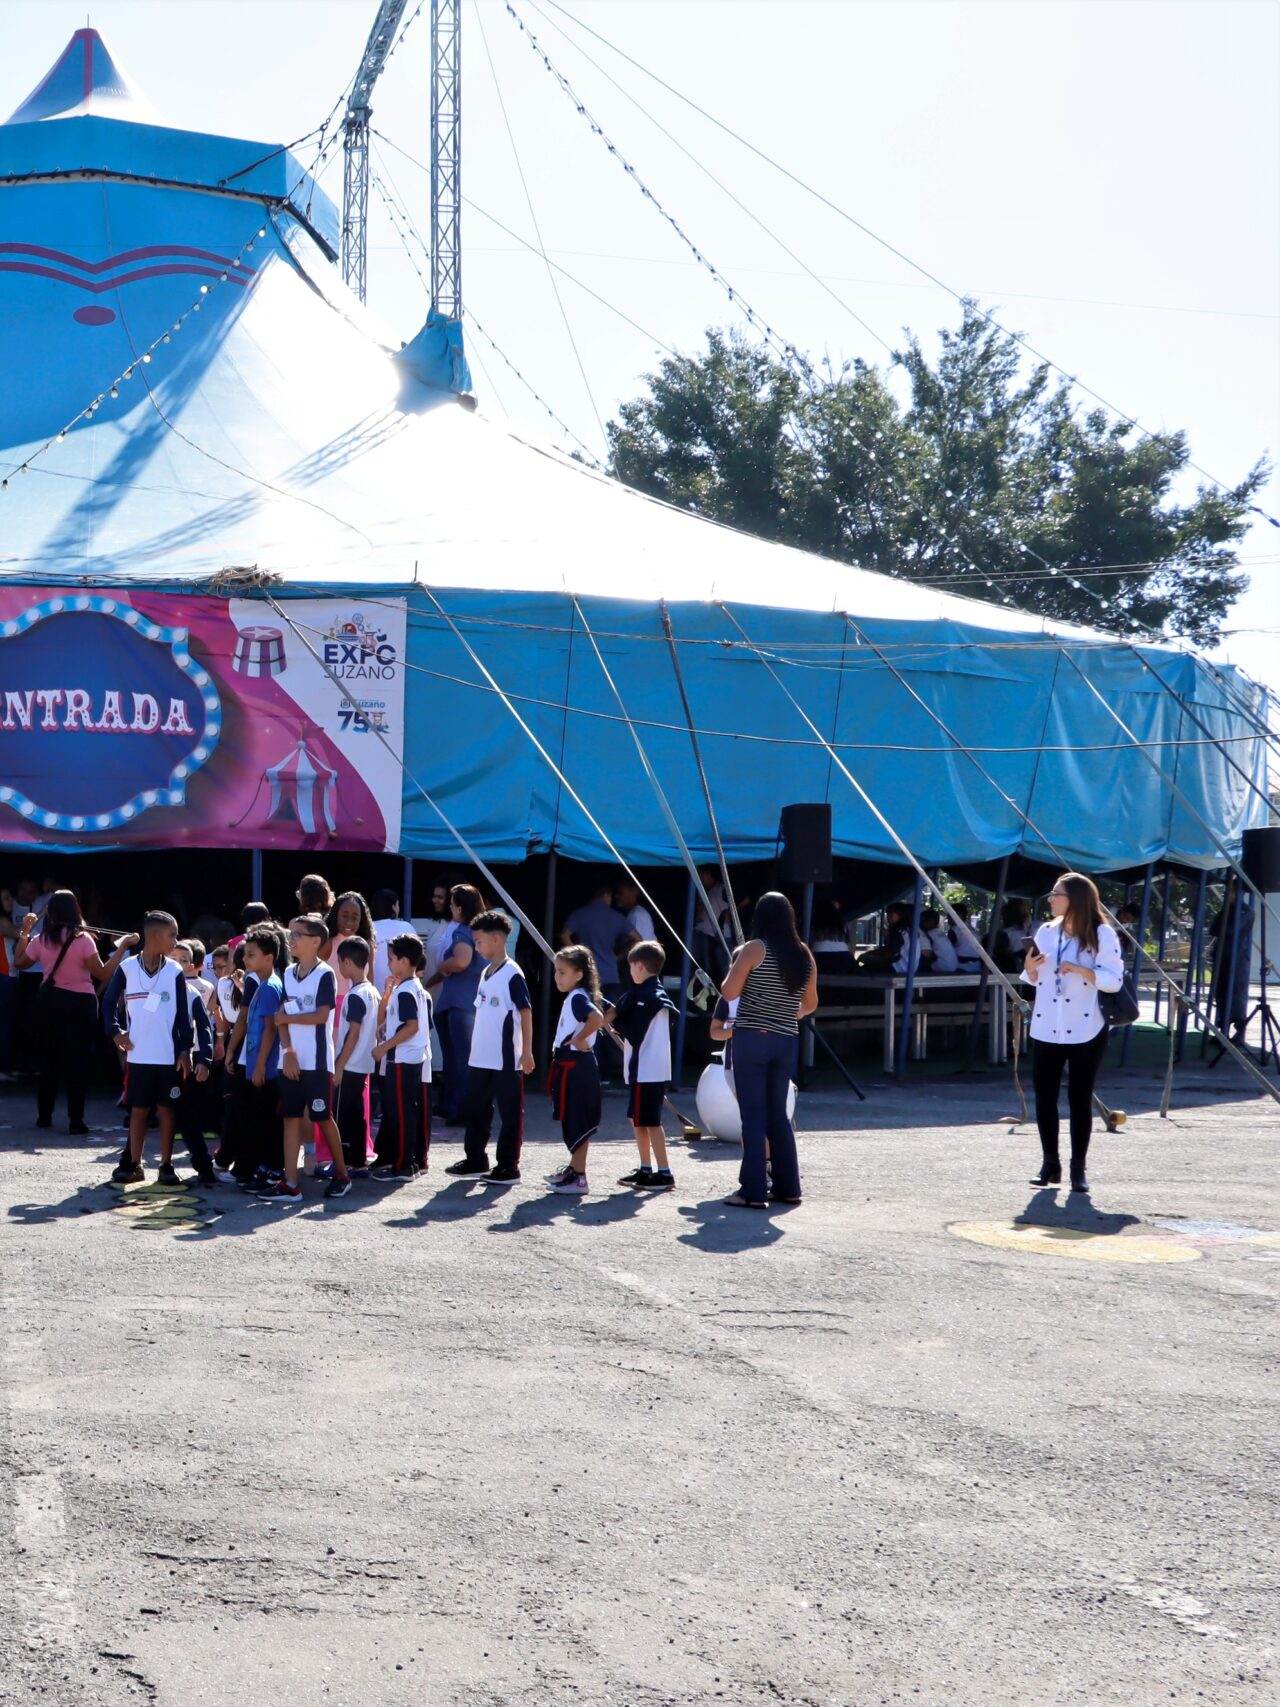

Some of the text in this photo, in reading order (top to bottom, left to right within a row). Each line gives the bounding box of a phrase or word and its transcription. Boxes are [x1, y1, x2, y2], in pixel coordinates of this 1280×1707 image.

[324, 644, 396, 666] EXPO
[353, 699, 386, 708] uzano
[337, 711, 369, 733] 75
